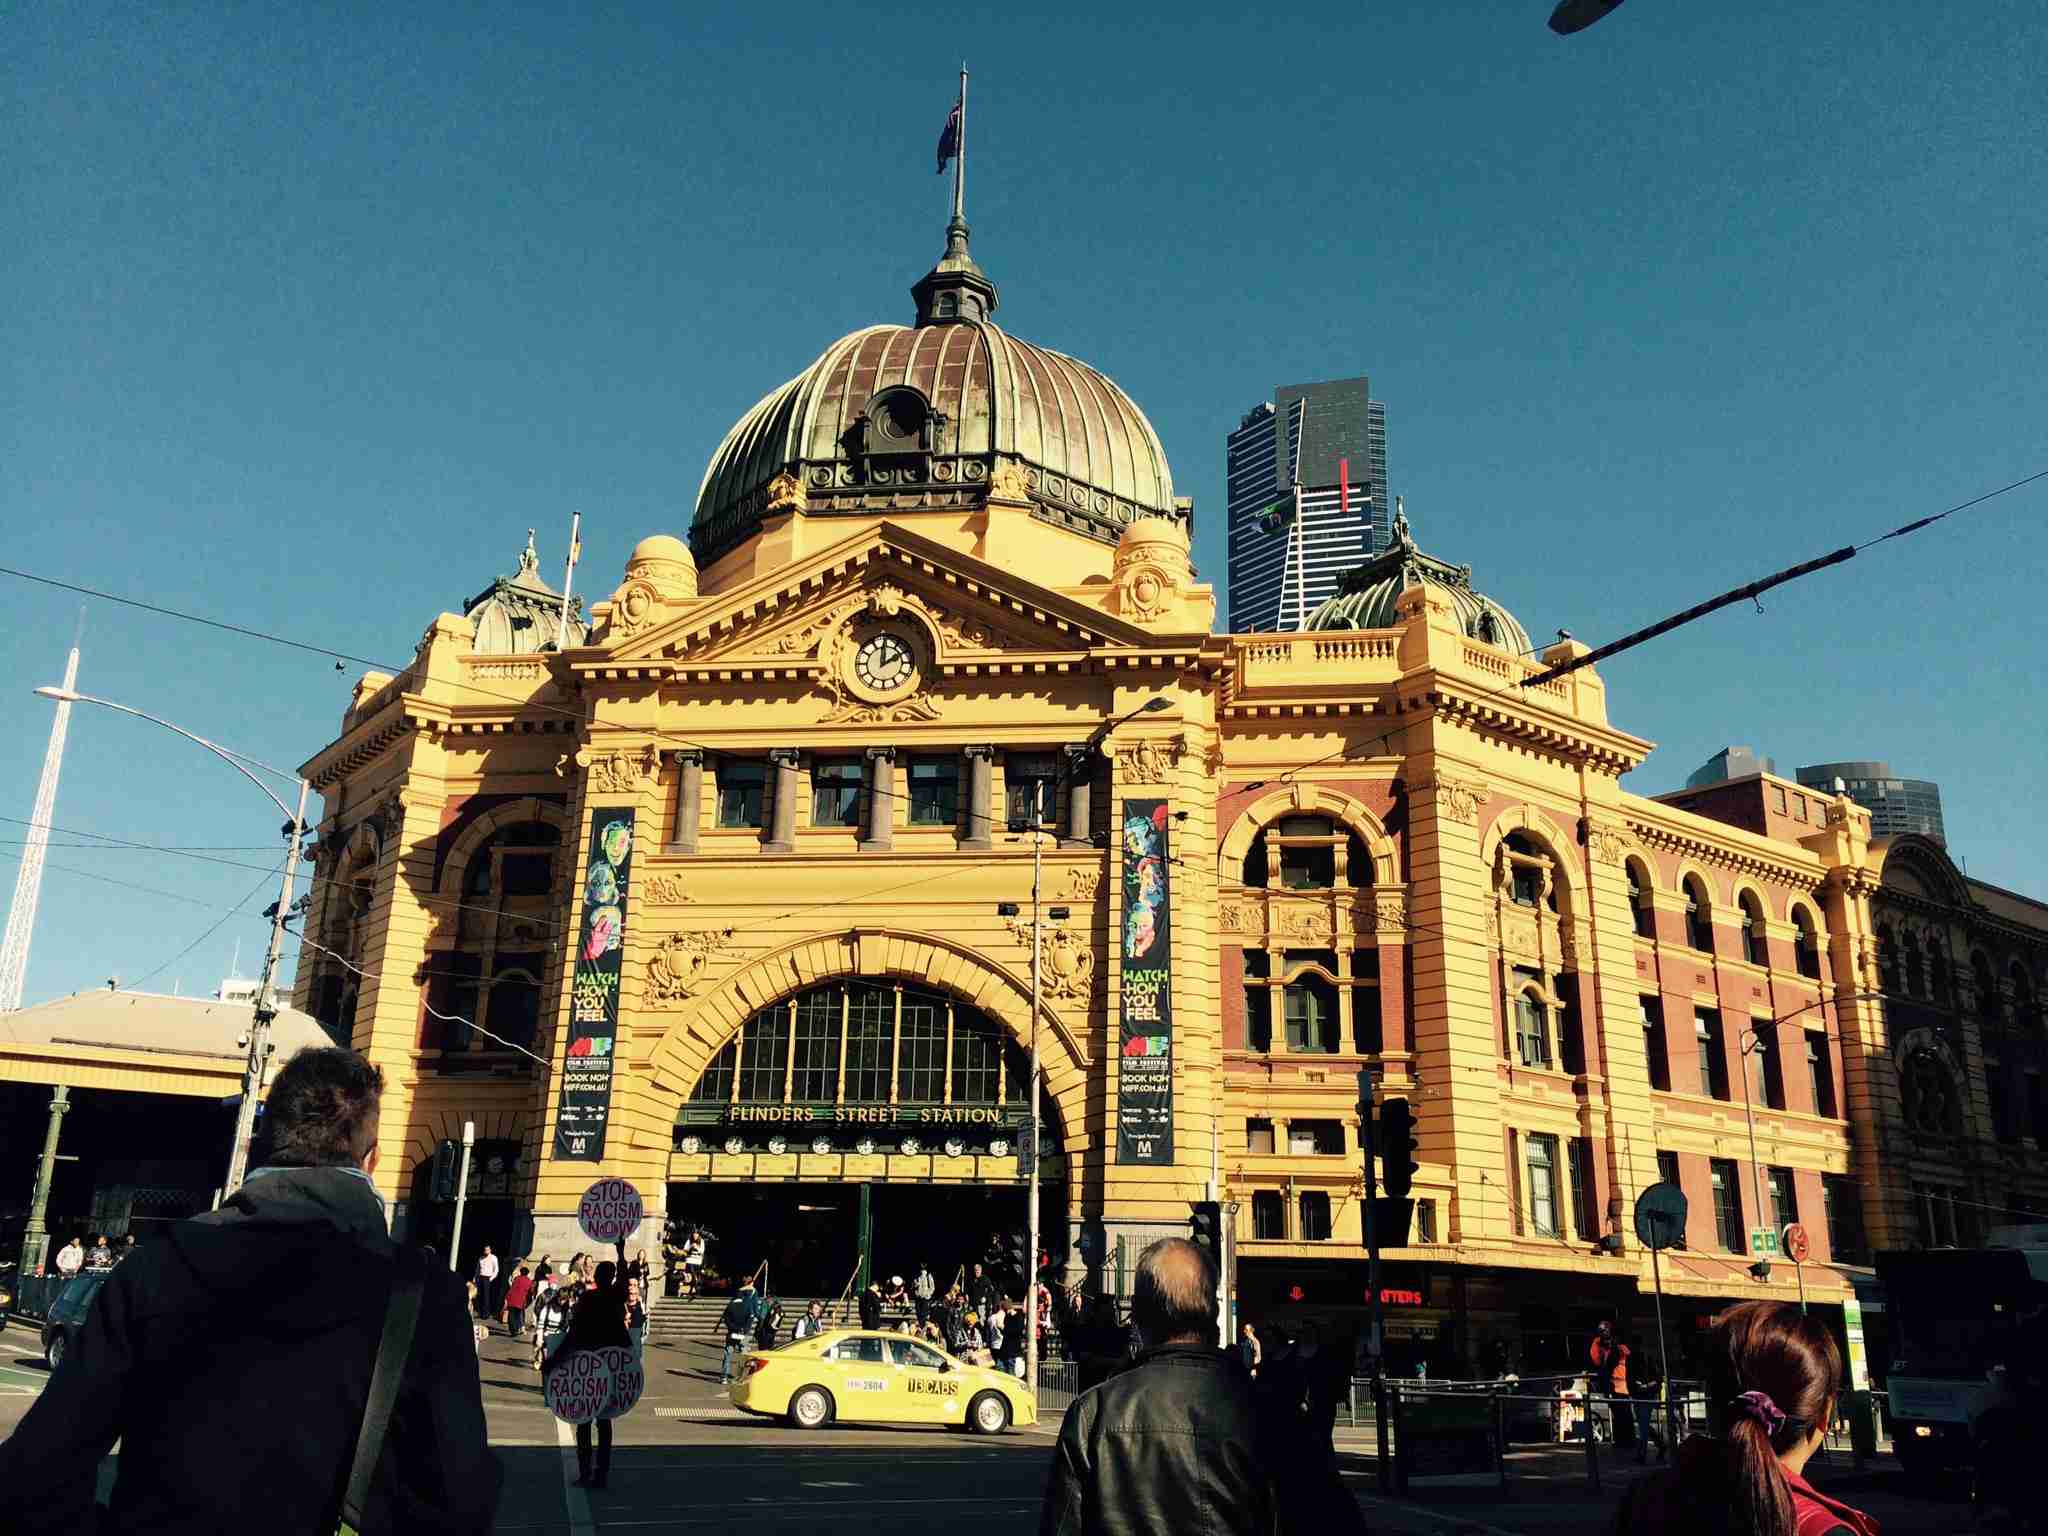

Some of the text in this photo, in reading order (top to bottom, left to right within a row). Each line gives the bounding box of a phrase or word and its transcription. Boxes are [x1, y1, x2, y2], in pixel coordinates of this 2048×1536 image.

[576, 972, 618, 985] WATCH
[1123, 969, 1169, 982] WATCH
[573, 985, 609, 998] HOW
[1121, 982, 1159, 995] HOW
[574, 996, 605, 1009] YOU
[1122, 994, 1156, 1008] YOU
[575, 1009, 609, 1022] FEEL
[1126, 1007, 1161, 1021] FEEL
[564, 1072, 610, 1083] BOOK NOW
[1122, 1073, 1169, 1083] BOOK NOW
[731, 1106, 1001, 1123] FLINDERS STREET STATION
[590, 1182, 633, 1202] STOP
[581, 1202, 640, 1220] RACISM
[588, 1219, 634, 1238] NOW
[558, 1354, 602, 1377] STOP
[551, 1376, 608, 1399] RACISM
